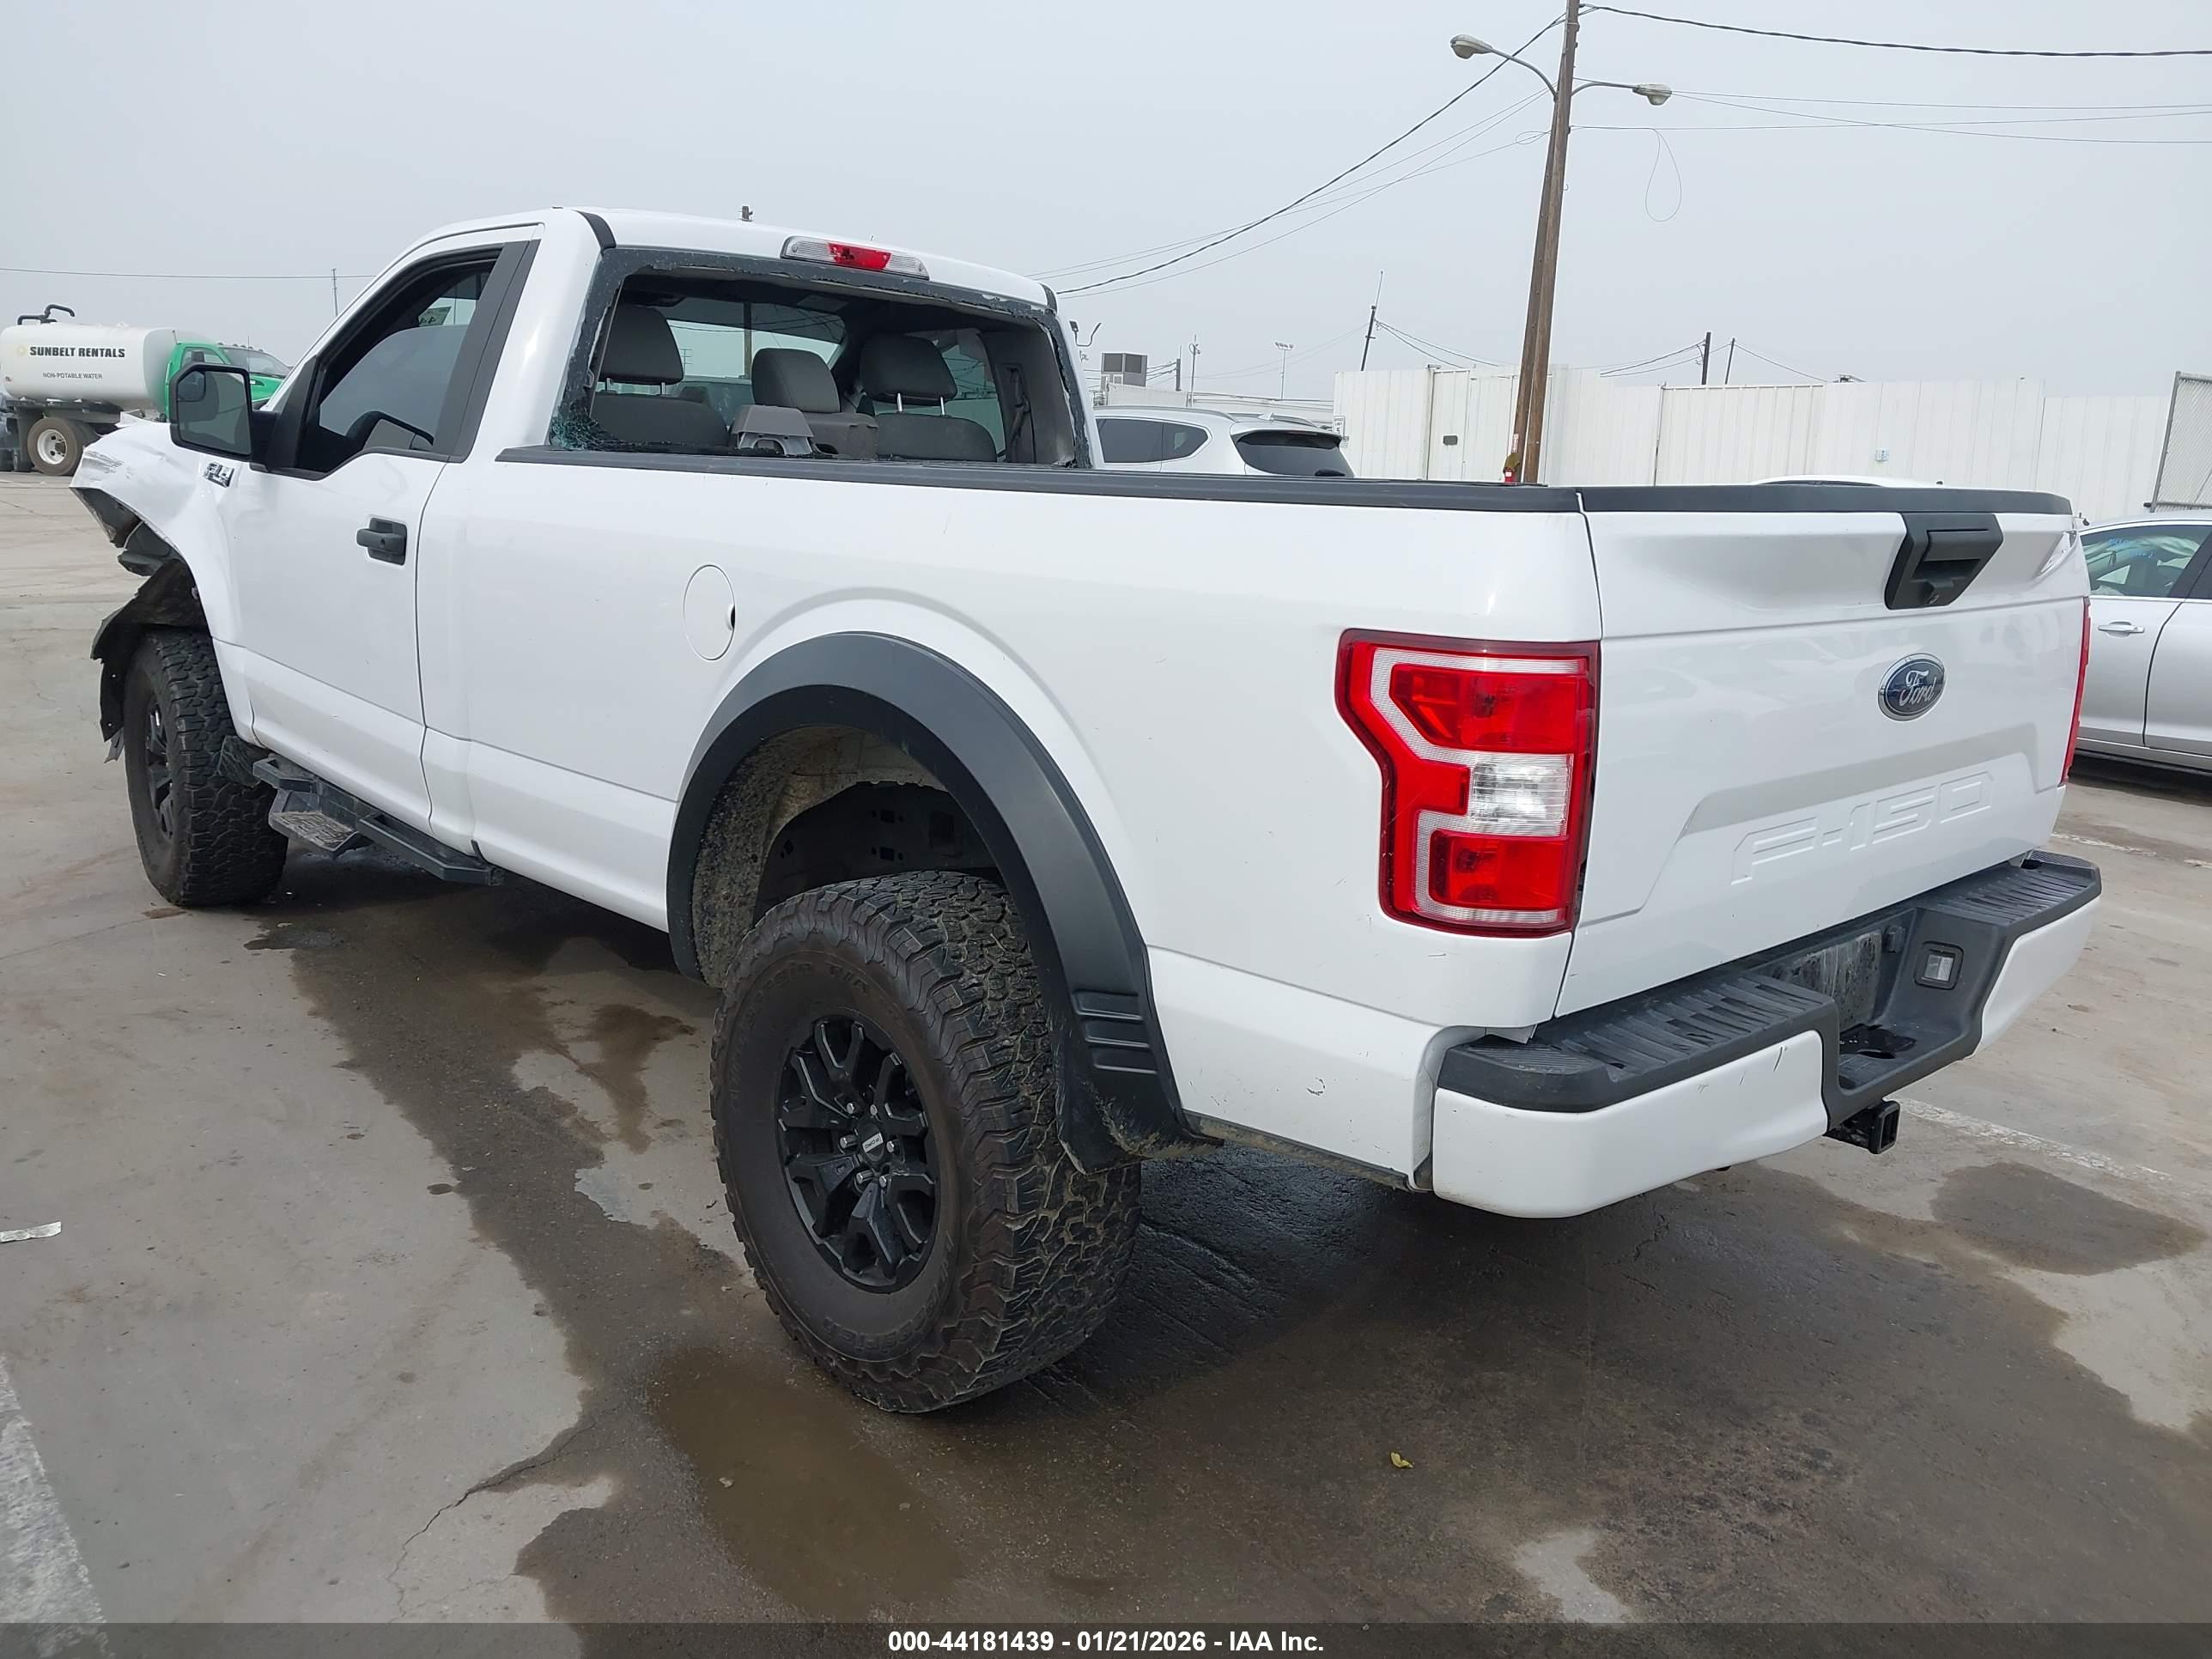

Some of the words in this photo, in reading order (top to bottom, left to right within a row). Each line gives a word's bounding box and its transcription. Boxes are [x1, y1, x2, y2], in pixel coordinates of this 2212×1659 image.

[30, 346, 76, 357] SUNBELT
[78, 348, 125, 358] RENTALS
[1899, 670, 1937, 708] Ford
[1730, 770, 1994, 886] F-150
